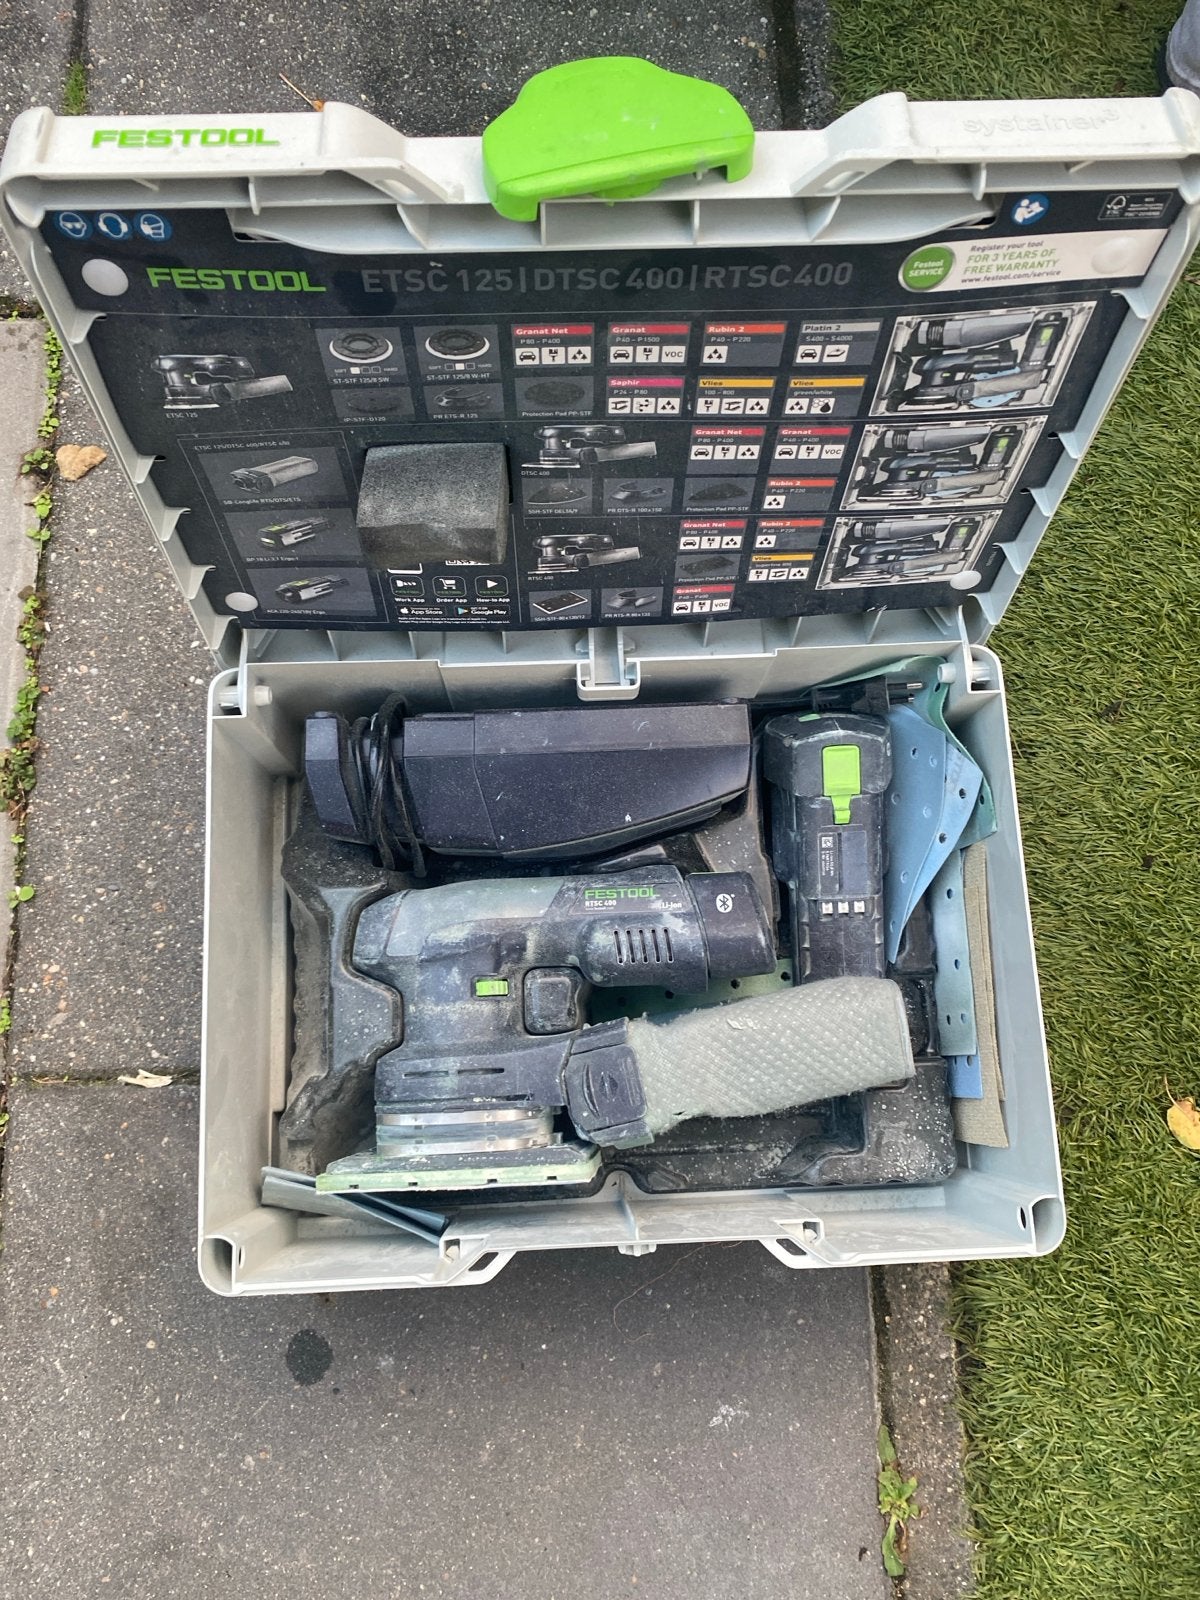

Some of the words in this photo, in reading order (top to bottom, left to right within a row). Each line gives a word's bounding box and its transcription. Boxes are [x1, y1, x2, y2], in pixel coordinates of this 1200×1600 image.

[92, 128, 280, 148] FESTOOL
[971, 244, 1006, 252] Register
[1007, 242, 1026, 250] your
[967, 254, 989, 263] FOR
[992, 253, 999, 262] 3
[1002, 250, 1038, 260] YEARS
[1040, 248, 1056, 258] OF
[913, 260, 944, 268] Festool
[964, 264, 993, 274] FREE
[995, 259, 1060, 273] WARRANTY
[361, 268, 448, 293] ETSC
[625, 266, 684, 290] 400
[704, 265, 792, 289] RTSC
[793, 262, 853, 286] 400
[908, 267, 943, 277] SERVICE
[961, 270, 1061, 283] www.festool.com/service
[146, 267, 326, 292] FESTOOL
[610, 379, 640, 387] Saphir
[585, 887, 660, 899] FESTOOL
